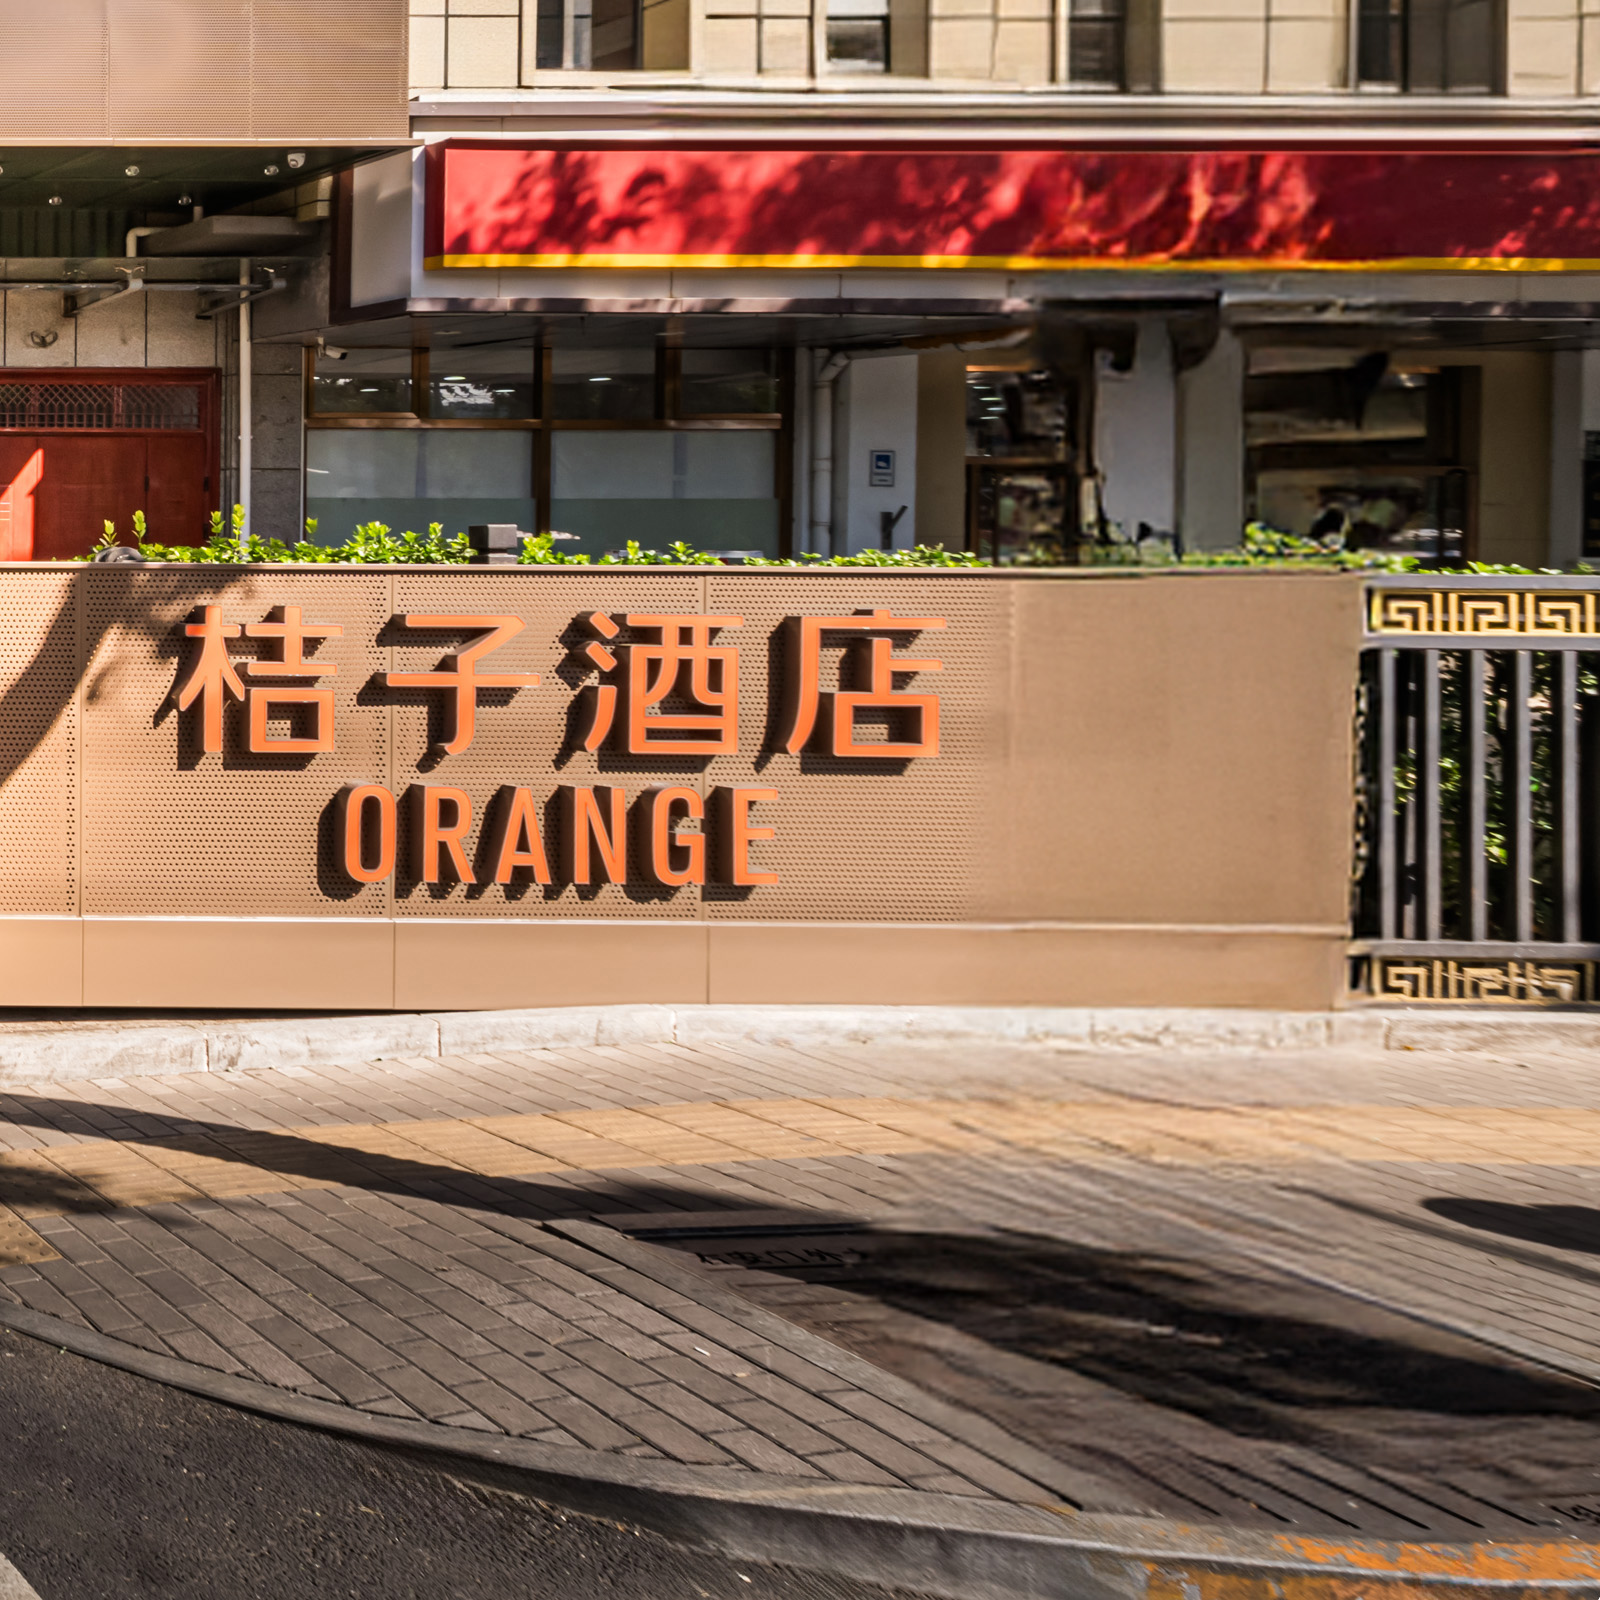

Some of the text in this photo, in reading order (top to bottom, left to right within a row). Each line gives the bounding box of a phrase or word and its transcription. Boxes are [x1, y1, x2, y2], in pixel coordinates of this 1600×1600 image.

[179, 605, 948, 758] 桔子酒店
[344, 785, 780, 887] ORANGE
